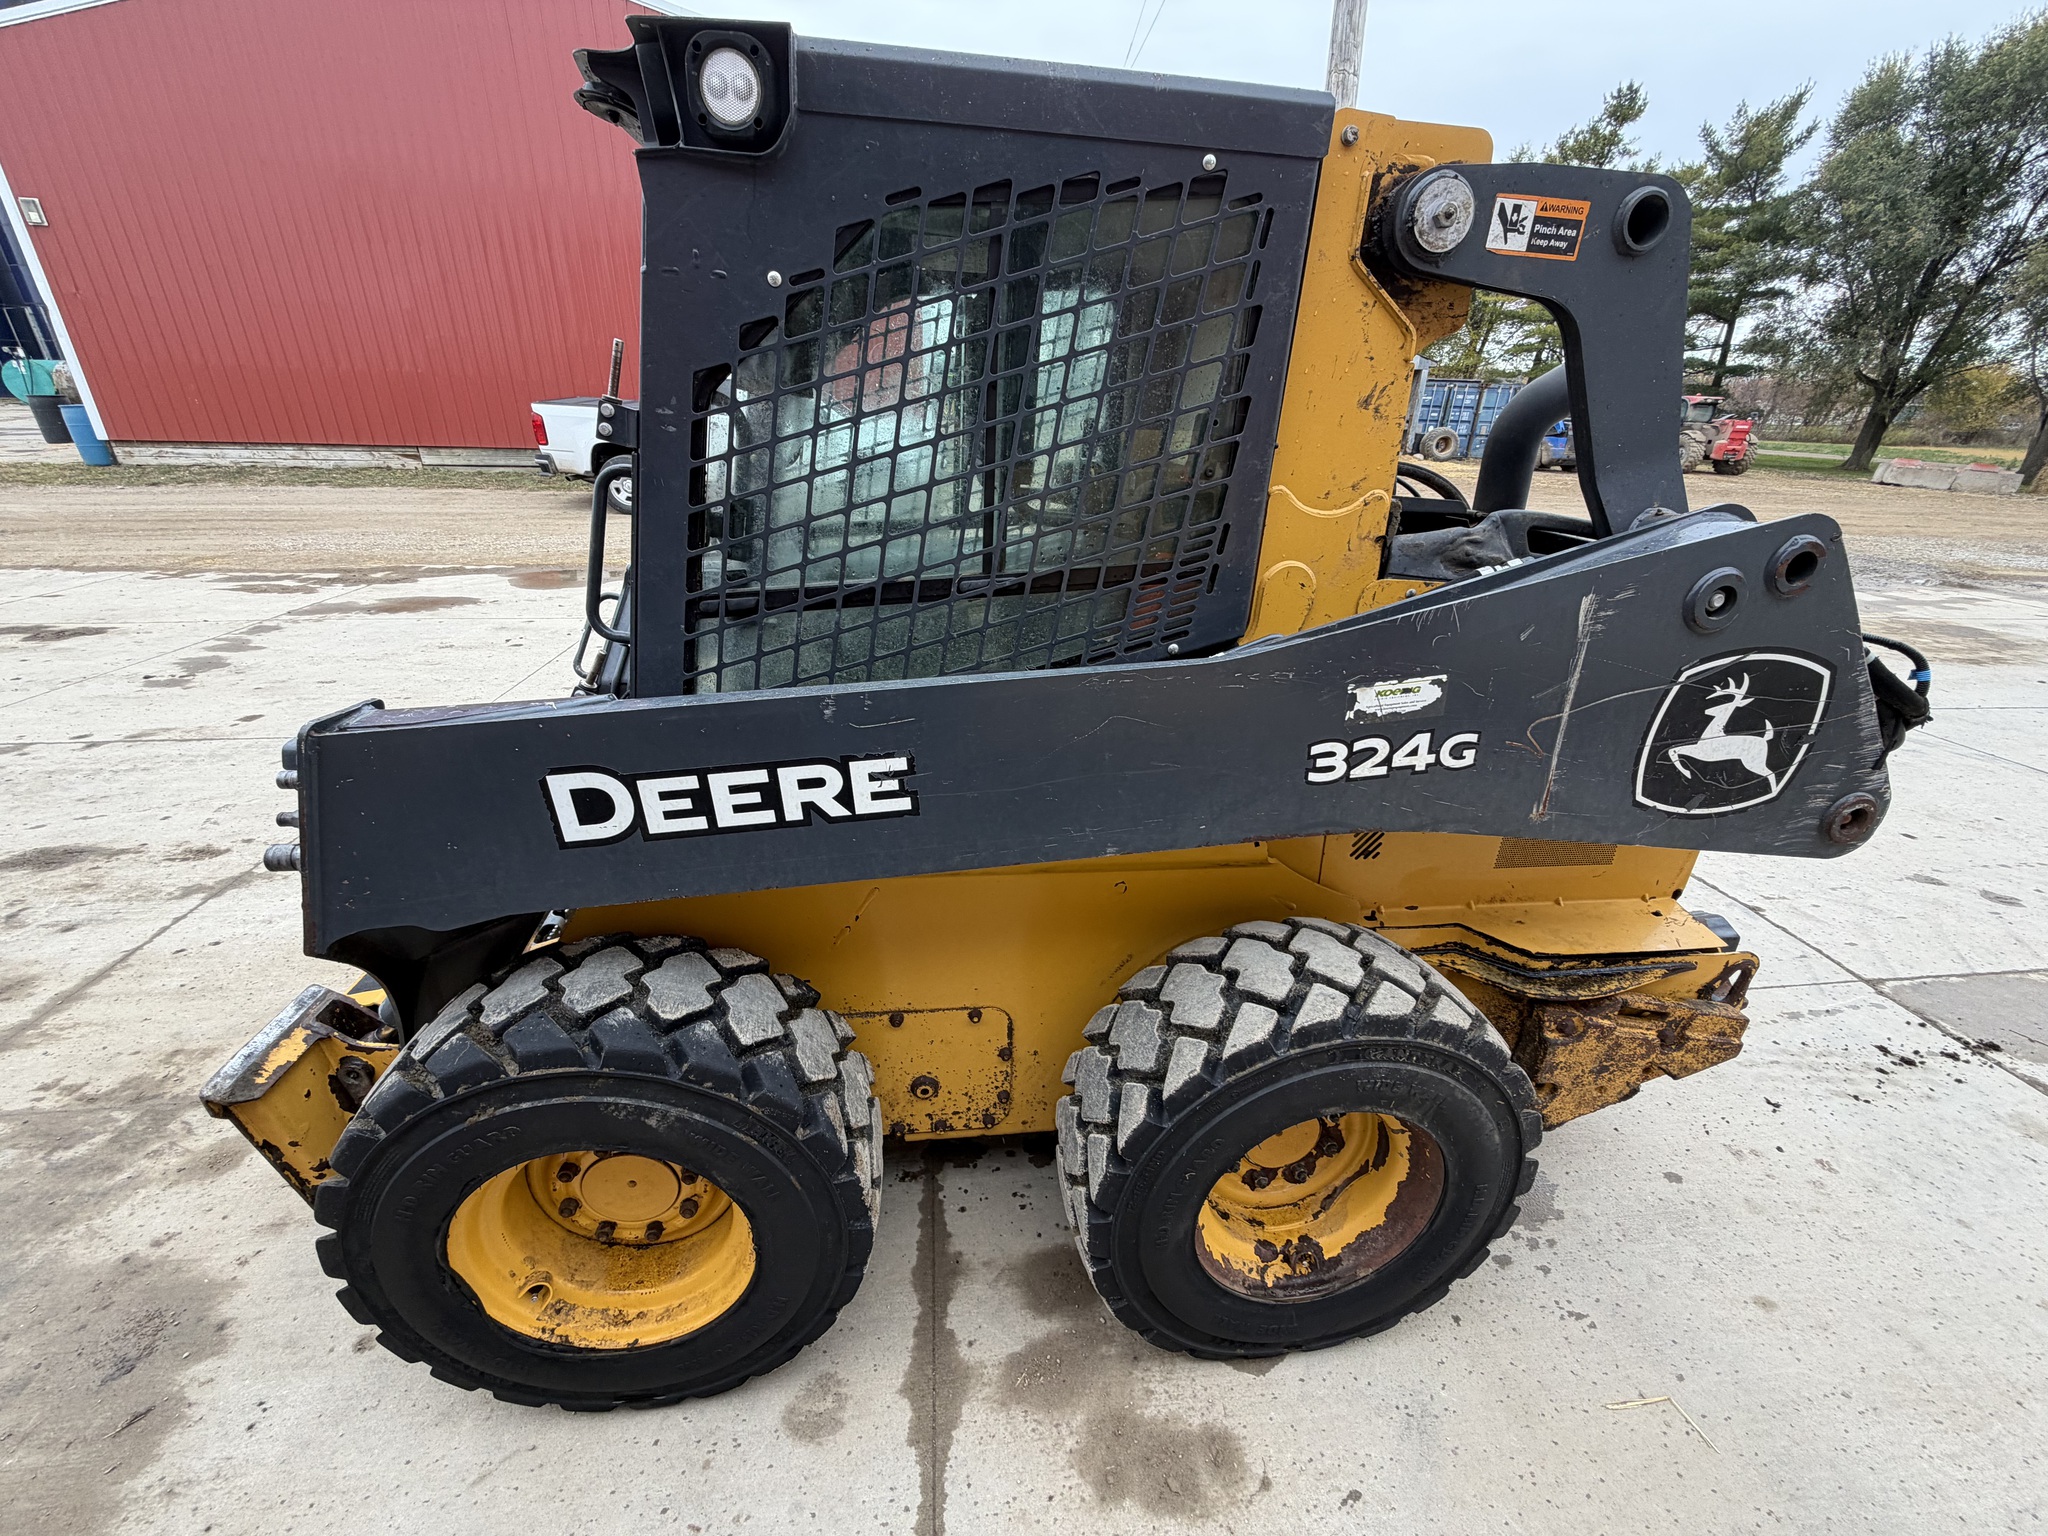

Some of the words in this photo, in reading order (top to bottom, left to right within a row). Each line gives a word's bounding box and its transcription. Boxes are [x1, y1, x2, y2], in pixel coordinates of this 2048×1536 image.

[1548, 203, 1584, 215] WARNING
[1533, 224, 1557, 235] Pinch
[1557, 226, 1577, 237] Area
[1530, 237, 1549, 248] Keep
[1549, 239, 1569, 250] Away
[1307, 732, 1479, 783] 324G
[545, 756, 912, 843] DEERE
